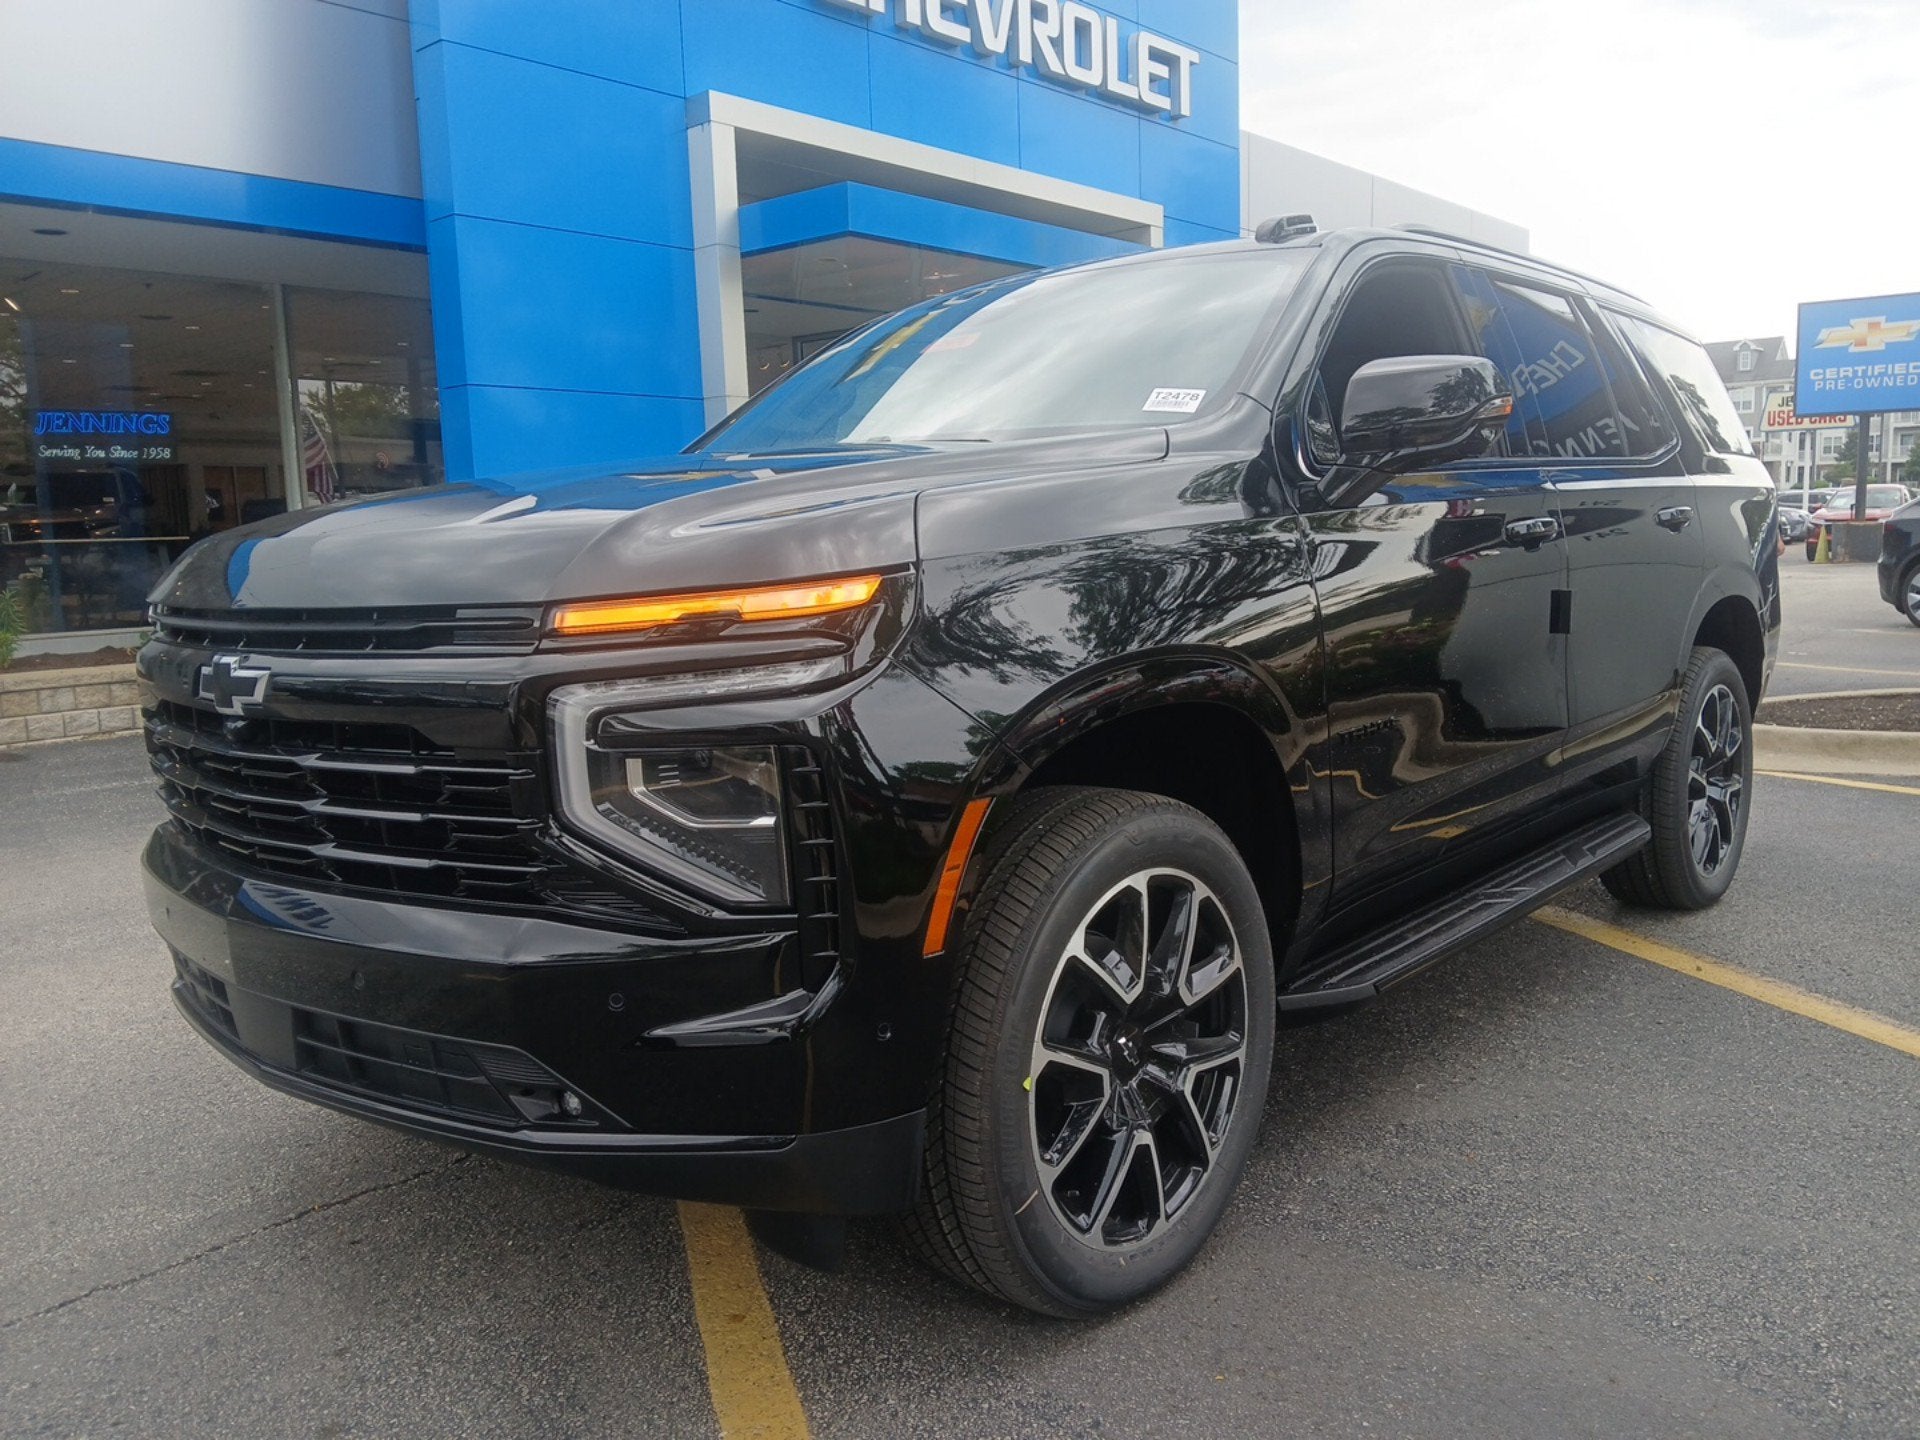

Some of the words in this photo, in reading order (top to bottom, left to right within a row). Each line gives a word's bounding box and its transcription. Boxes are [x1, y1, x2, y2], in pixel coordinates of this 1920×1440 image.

[842, 0, 1200, 118] EVROLET
[1809, 362, 1920, 380] CERTIFIED
[1814, 374, 1918, 391] PRE-OWNED
[1155, 391, 1200, 401] T2478
[35, 411, 171, 435] JENNINGS
[38, 445, 80, 460] Serving
[85, 445, 105, 458] You
[109, 446, 138, 459] Since
[142, 447, 171, 459] 1958
